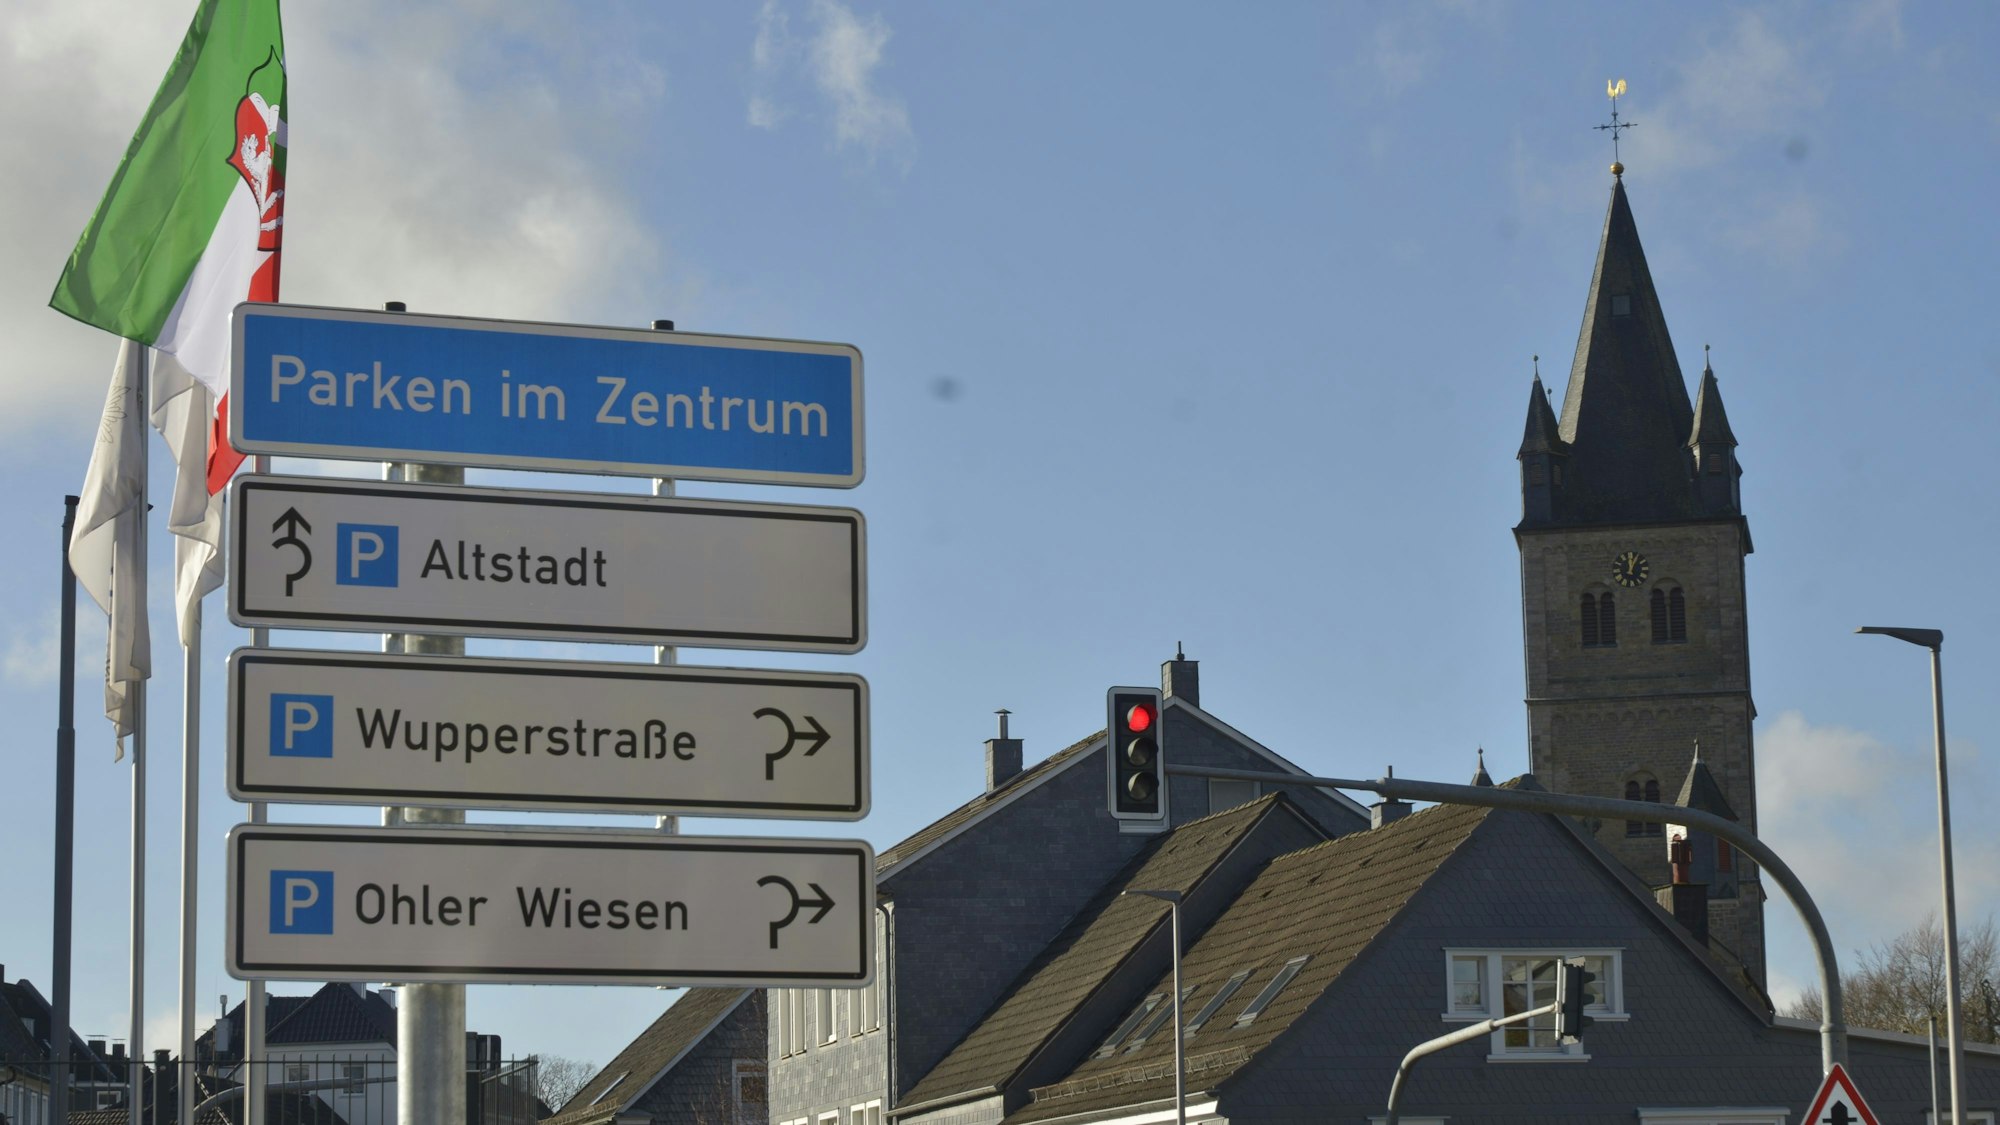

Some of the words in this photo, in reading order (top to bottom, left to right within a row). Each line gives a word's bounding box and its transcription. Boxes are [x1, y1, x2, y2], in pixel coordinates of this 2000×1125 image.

[271, 354, 471, 415] Parken
[501, 369, 566, 421] im
[595, 376, 828, 437] Zentrum
[350, 531, 385, 578] P
[420, 539, 607, 588] Altstadt
[284, 701, 319, 749] P
[355, 707, 697, 764] Wupperstraße
[284, 878, 319, 927] P
[355, 882, 489, 927] Ohler
[516, 886, 688, 931] Wiesen
